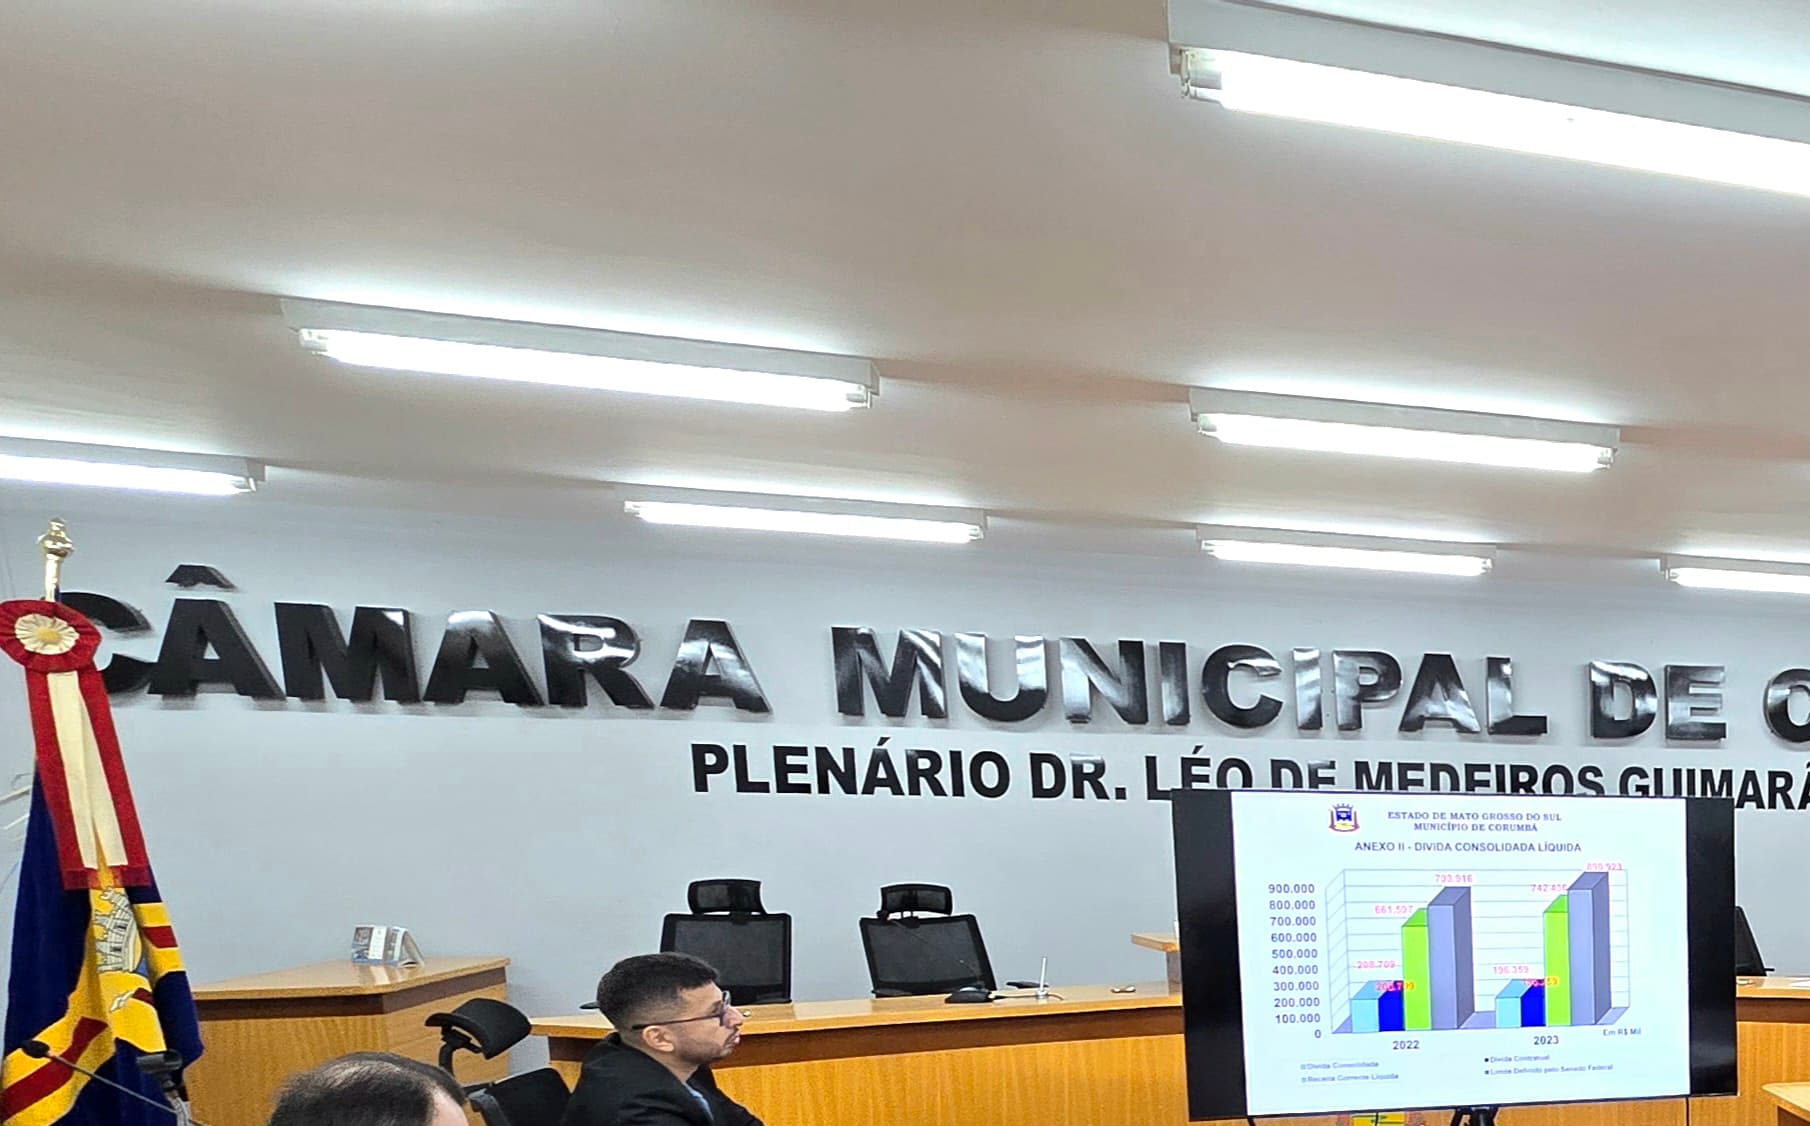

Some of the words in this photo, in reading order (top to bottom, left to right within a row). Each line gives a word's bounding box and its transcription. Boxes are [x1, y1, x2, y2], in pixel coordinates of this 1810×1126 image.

[62, 563, 773, 715] CÂMARA
[830, 626, 1548, 736] MUNICIPAL
[1588, 660, 1728, 742] DE
[690, 737, 1011, 798] PLENÁRIO
[1029, 752, 1127, 800] DR.
[1145, 745, 1253, 800] LÉO
[1270, 758, 1336, 791] DE
[1354, 760, 1605, 795] MEDEIROS
[1387, 811, 1430, 821] ESTADO
[1433, 811, 1447, 821] DE
[1450, 812, 1480, 821] MATO
[1482, 812, 1524, 821] GROSSO
[1526, 813, 1540, 821] DO
[1543, 813, 1562, 822] SUL
[1413, 821, 1469, 831] MUNICÍPIO
[1471, 823, 1486, 832] DE
[1488, 822, 1538, 832] CORUMBÁ
[1354, 841, 1395, 851] ANEXO
[1398, 841, 1405, 851] II
[1455, 841, 1536, 852] CONSOLIDADA
[1538, 840, 1583, 852] LÍQUIDA
[1268, 884, 1315, 894] 900.000
[1269, 900, 1316, 910] 800.000
[1270, 916, 1317, 926] 700.000
[1271, 932, 1317, 943] 600.000
[1271, 949, 1318, 959] 500.000
[1272, 965, 1319, 975] 400.000
[1273, 981, 1320, 991] 300.000
[1274, 997, 1320, 1008] 200.000
[1275, 1013, 1321, 1024] 100.000
[1314, 1029, 1322, 1039] 0
[1392, 1040, 1420, 1050] 2022
[1533, 1035, 1560, 1045] 2023
